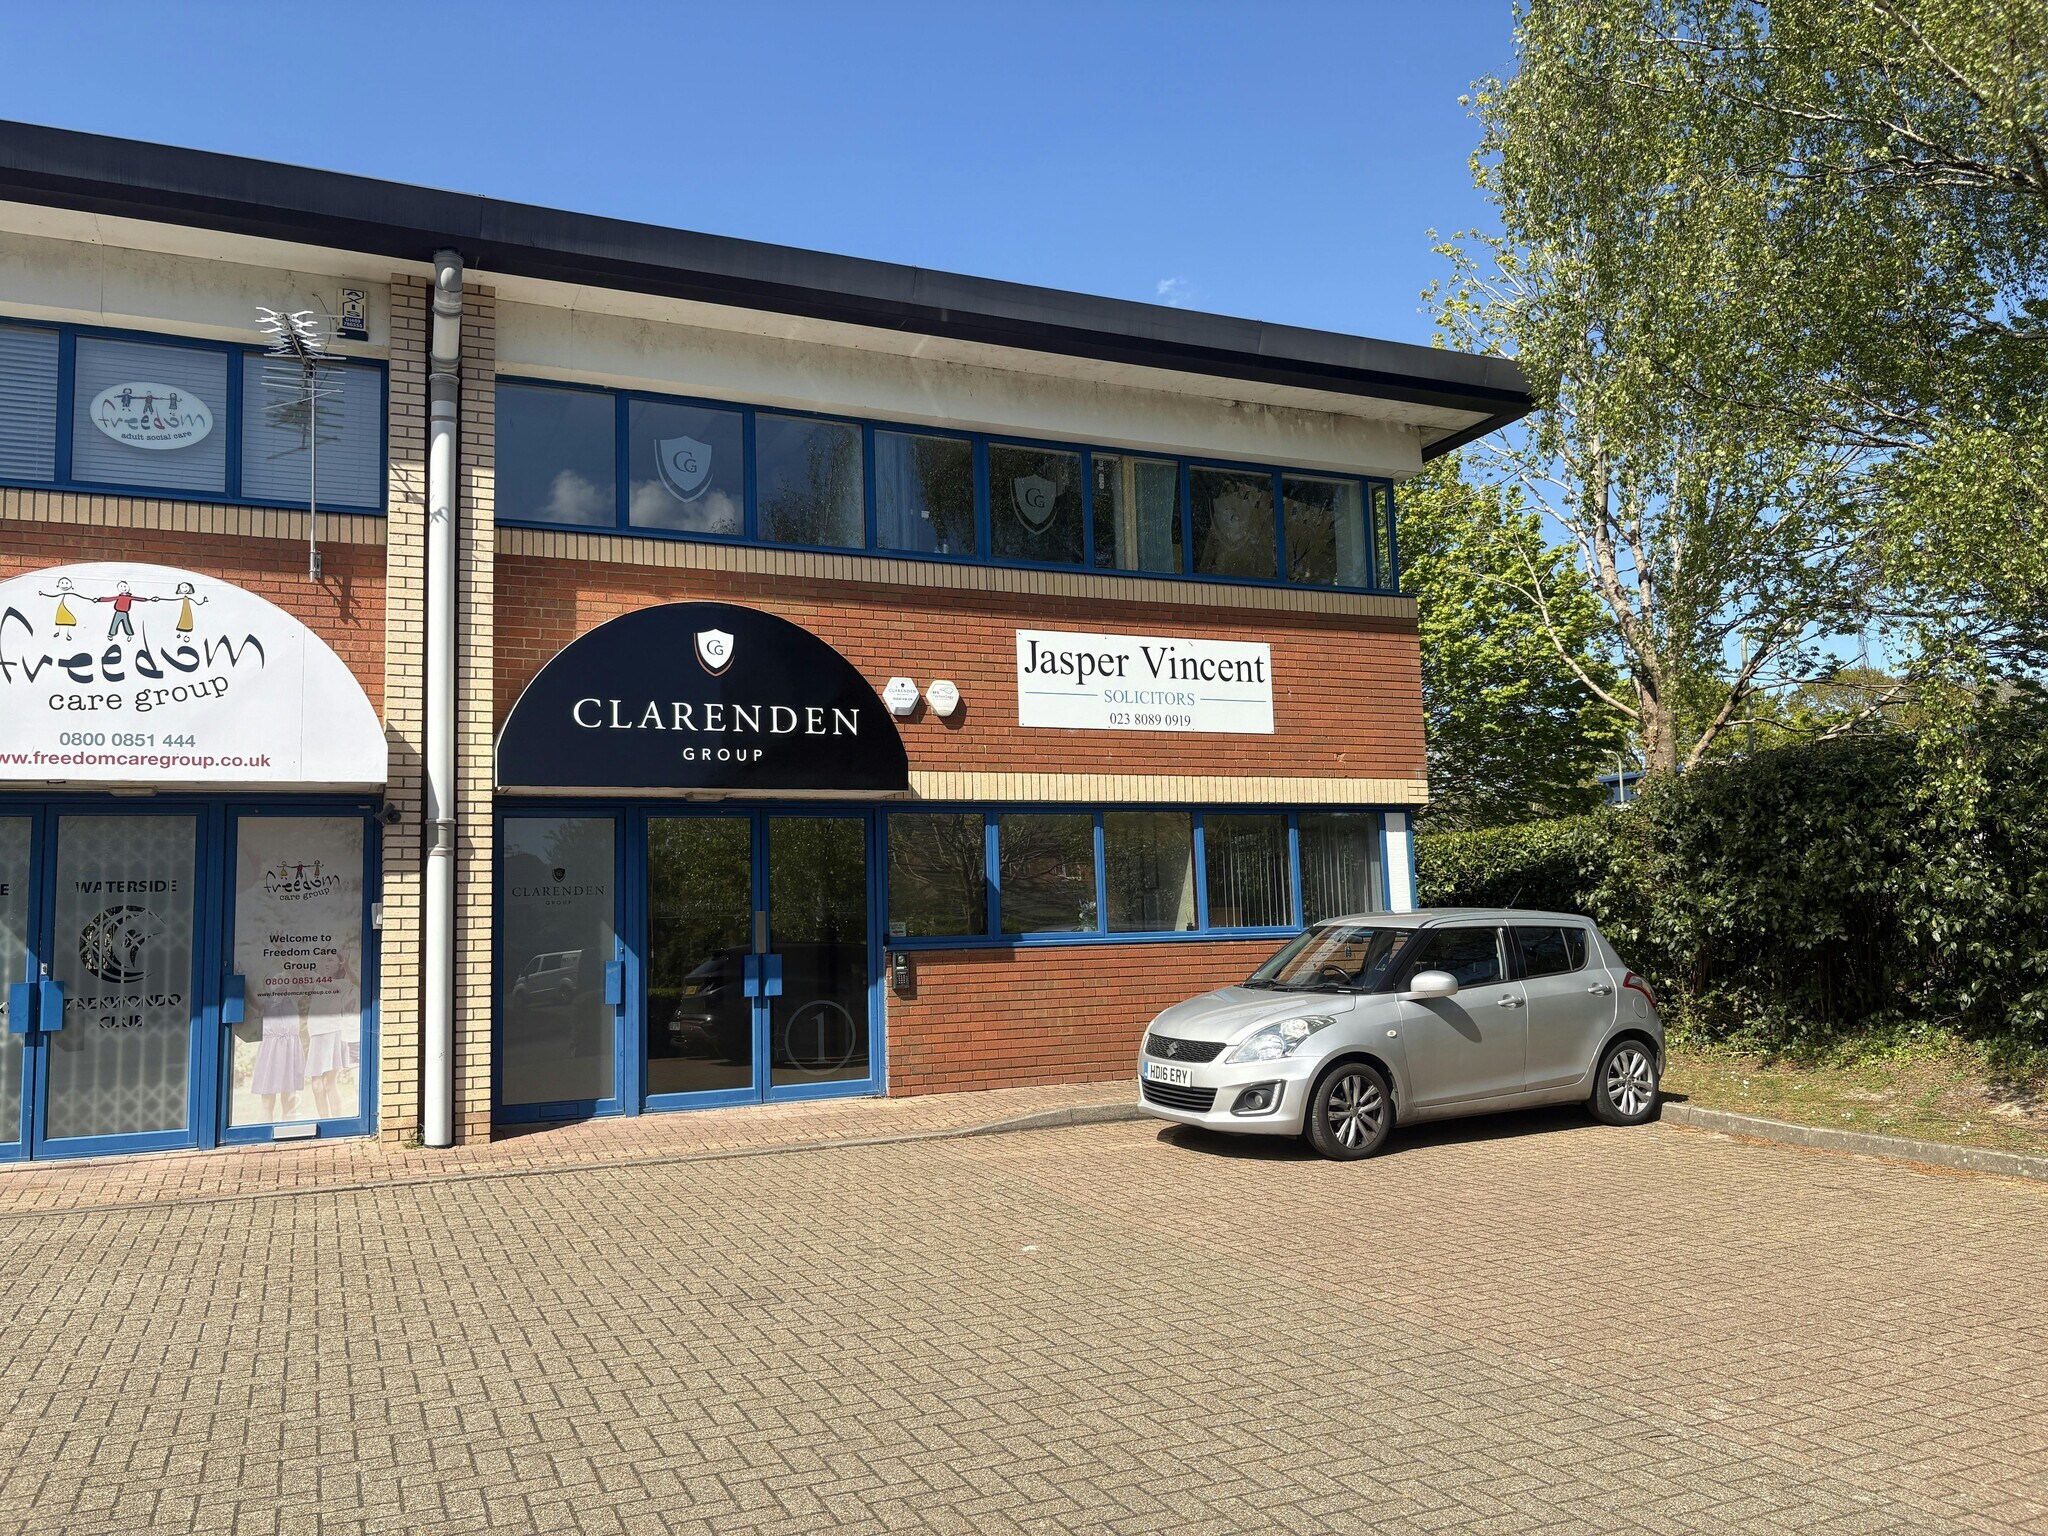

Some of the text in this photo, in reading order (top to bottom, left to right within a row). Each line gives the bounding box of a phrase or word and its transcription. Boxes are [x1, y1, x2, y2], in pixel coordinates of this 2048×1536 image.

[98, 399, 206, 430] freedom
[121, 433, 144, 441] adult
[173, 431, 192, 439] care
[0, 606, 265, 684] freedom
[1024, 640, 1266, 685] Jasper Vincent
[49, 675, 229, 712] care group
[1103, 689, 1196, 706] SOLICITORS
[573, 698, 860, 736] CLARENDEN
[1109, 713, 1191, 727] 023 8089 0919
[59, 732, 196, 748] 0800 0851 444
[682, 747, 763, 762] GROUP
[75, 880, 177, 893] WATERSIDE
[264, 870, 341, 893] freedom
[279, 887, 330, 901] care group
[511, 885, 605, 897] CLARENDEN
[269, 933, 332, 943] Welcome to
[263, 947, 337, 957] Freedom Care
[283, 961, 317, 971] Group
[265, 976, 333, 986] 0800 0851 444
[257, 988, 340, 998] www.freedomcaregroup.co.uk
[99, 1015, 143, 1029] CLUB
[1150, 1064, 1188, 1084] HD16 ERY
[286, 1094, 302, 1117] 2
